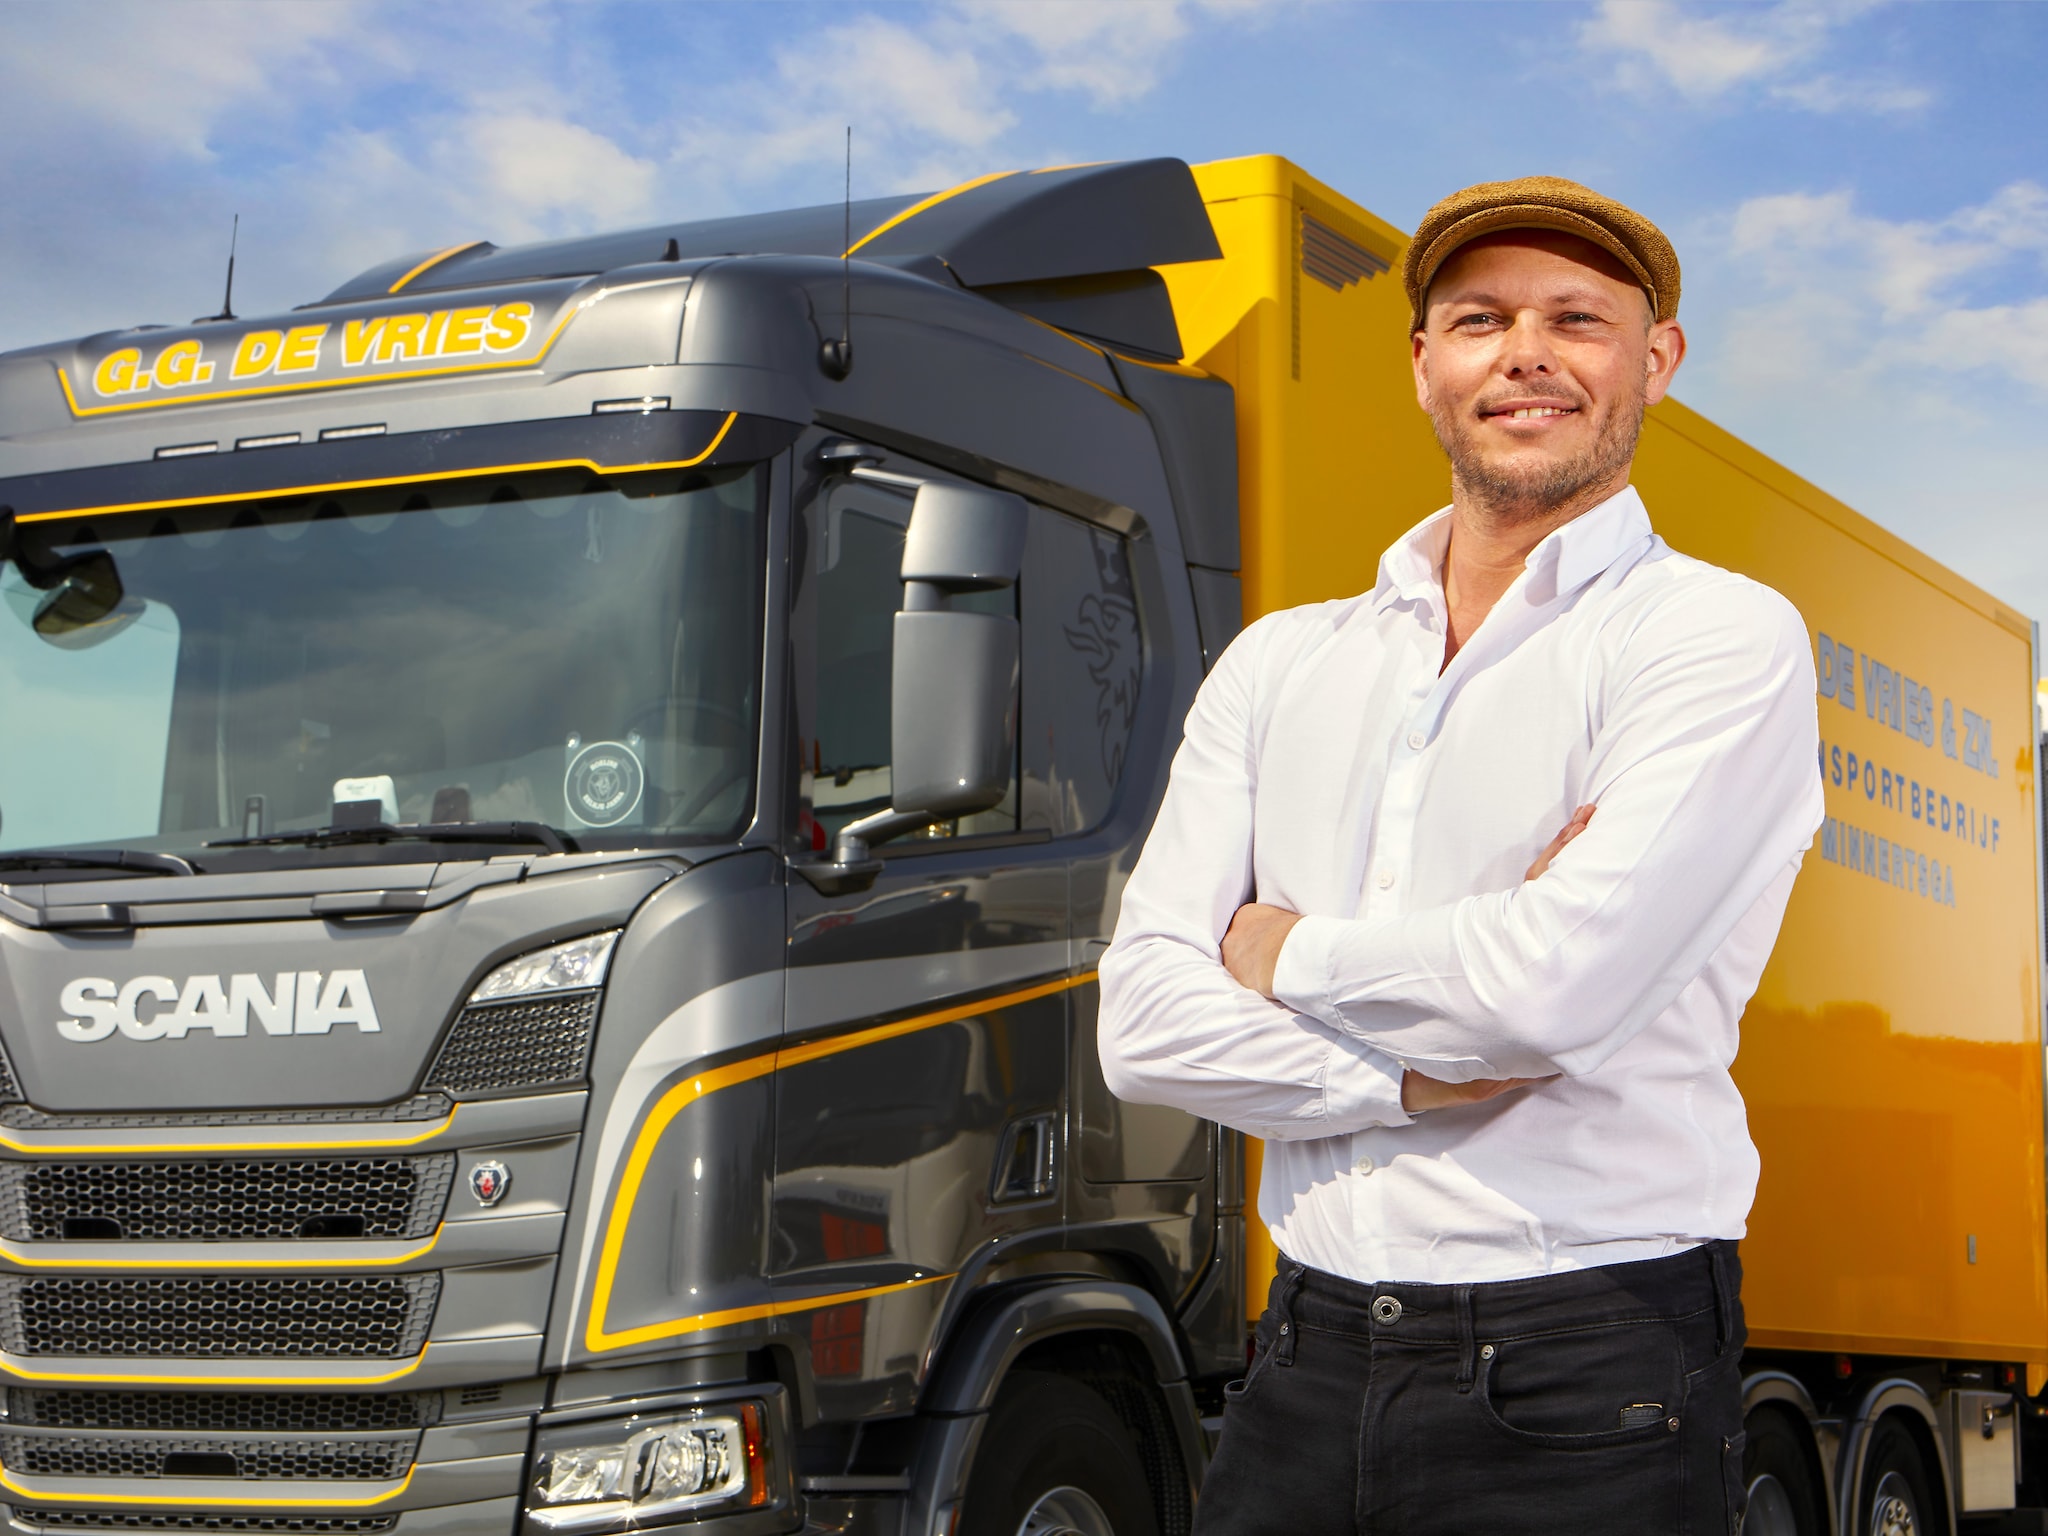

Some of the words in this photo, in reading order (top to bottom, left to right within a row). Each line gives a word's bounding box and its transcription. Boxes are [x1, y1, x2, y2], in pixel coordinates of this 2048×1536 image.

[93, 339, 216, 397] G.G.
[228, 323, 331, 381] DE
[341, 301, 534, 367] VRIES
[1818, 631, 1856, 711] DE
[1860, 653, 1935, 748] VRIES
[1941, 697, 1958, 760] &
[1818, 738, 2000, 854] NSPORTBEDRIJF
[1821, 815, 1956, 908] MINNERTSGA
[56, 968, 381, 1042] SCANIA
